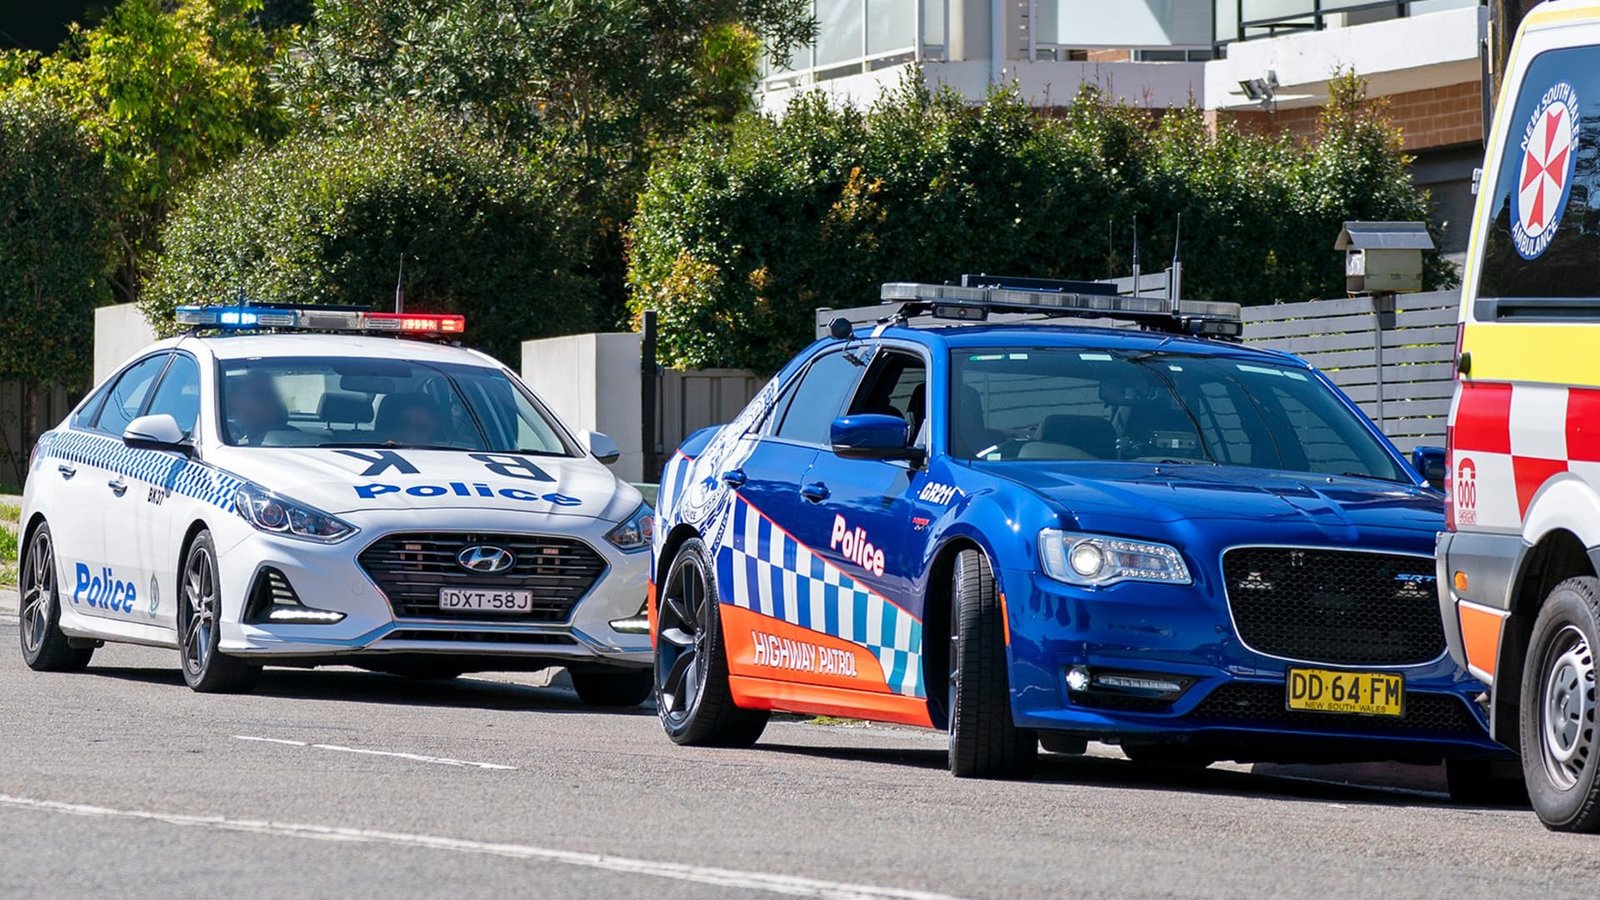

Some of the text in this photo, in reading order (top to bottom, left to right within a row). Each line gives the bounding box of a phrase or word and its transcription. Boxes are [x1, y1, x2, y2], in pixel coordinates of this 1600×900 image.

[1520, 82, 1580, 152] NEW SOUTH WALES
[1512, 215, 1558, 256] AMBULANCE
[147, 486, 165, 506] BK37
[919, 481, 956, 506] GR211
[1458, 480, 1476, 509] 000
[830, 513, 886, 578] Police
[73, 562, 137, 614] Police
[1394, 573, 1437, 584] SRT
[751, 630, 858, 678] HIGHWAY PATROL
[1327, 702, 1356, 711] SOUTH
[1360, 705, 1387, 713] WALES
